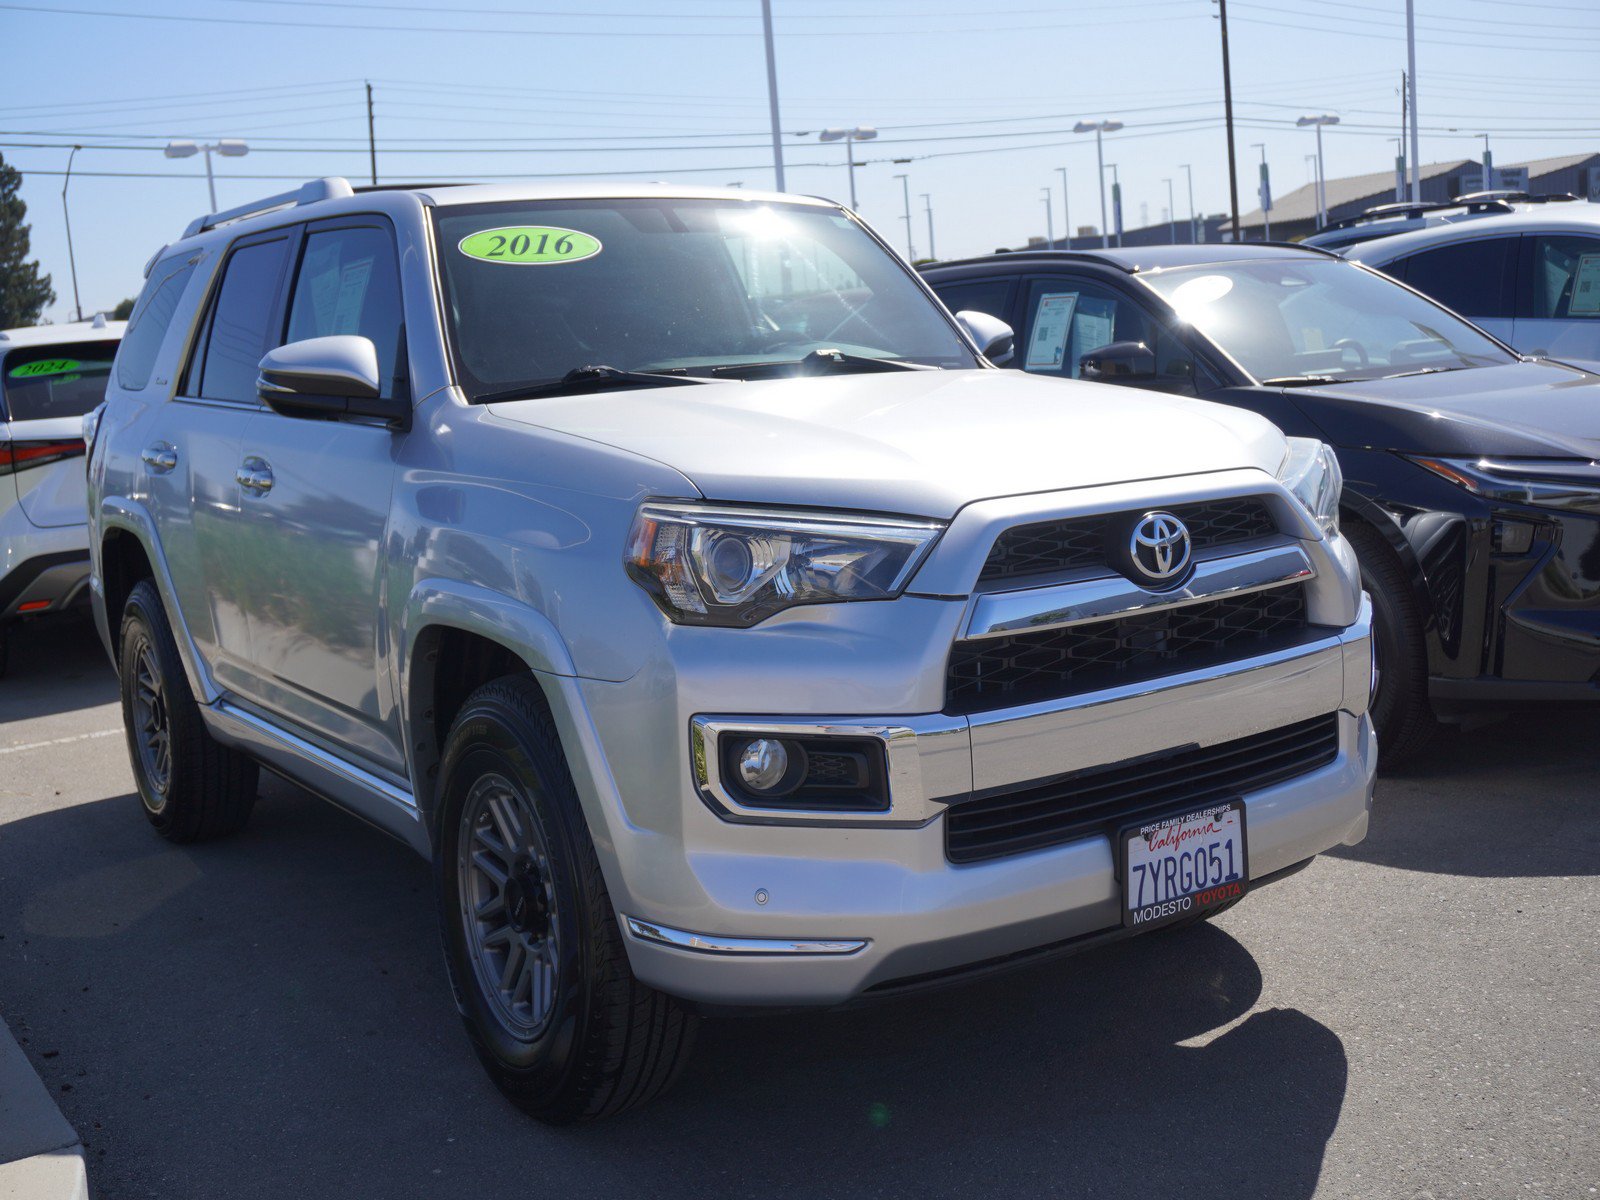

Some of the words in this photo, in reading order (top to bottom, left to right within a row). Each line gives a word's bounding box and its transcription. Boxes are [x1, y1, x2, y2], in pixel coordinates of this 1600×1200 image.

[485, 234, 574, 256] 2016
[21, 361, 69, 375] 2024
[1140, 822, 1160, 835] PRICE
[1161, 816, 1186, 829] FAMILY
[1186, 804, 1231, 822] DEALERSHIPS
[1148, 821, 1222, 852] California
[1132, 838, 1239, 907] 7YRG051
[1133, 897, 1192, 925] MODESTO
[1195, 883, 1241, 906] TOYOTA
